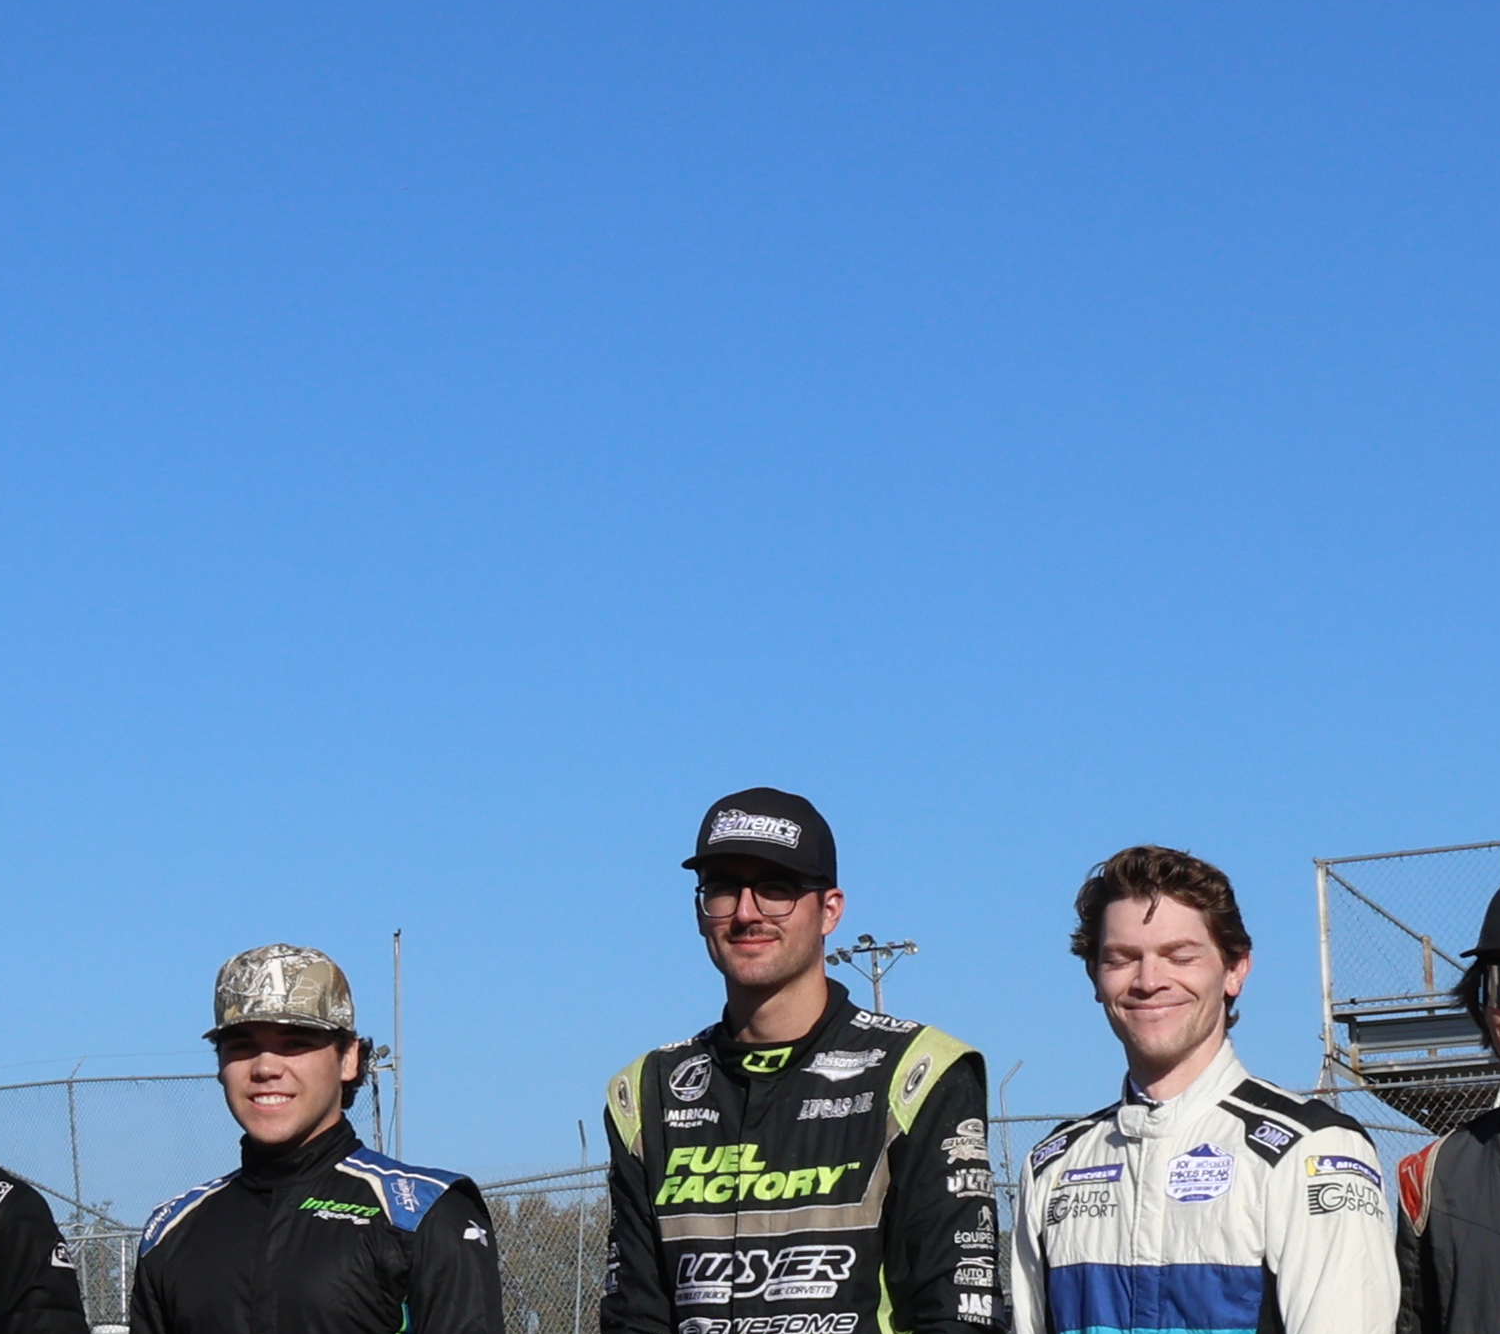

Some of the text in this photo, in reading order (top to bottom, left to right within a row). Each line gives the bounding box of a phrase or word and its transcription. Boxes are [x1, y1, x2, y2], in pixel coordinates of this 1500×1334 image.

[797, 1097, 851, 1121] LUCAS
[1255, 1122, 1292, 1147] OMP
[665, 1144, 766, 1175] FUEL
[1202, 1167, 1231, 1179] PEAK
[655, 1164, 847, 1205] FACTORY
[299, 1197, 381, 1217] Interra
[1072, 1191, 1111, 1204] AUTO
[1071, 1203, 1118, 1219] SPORT
